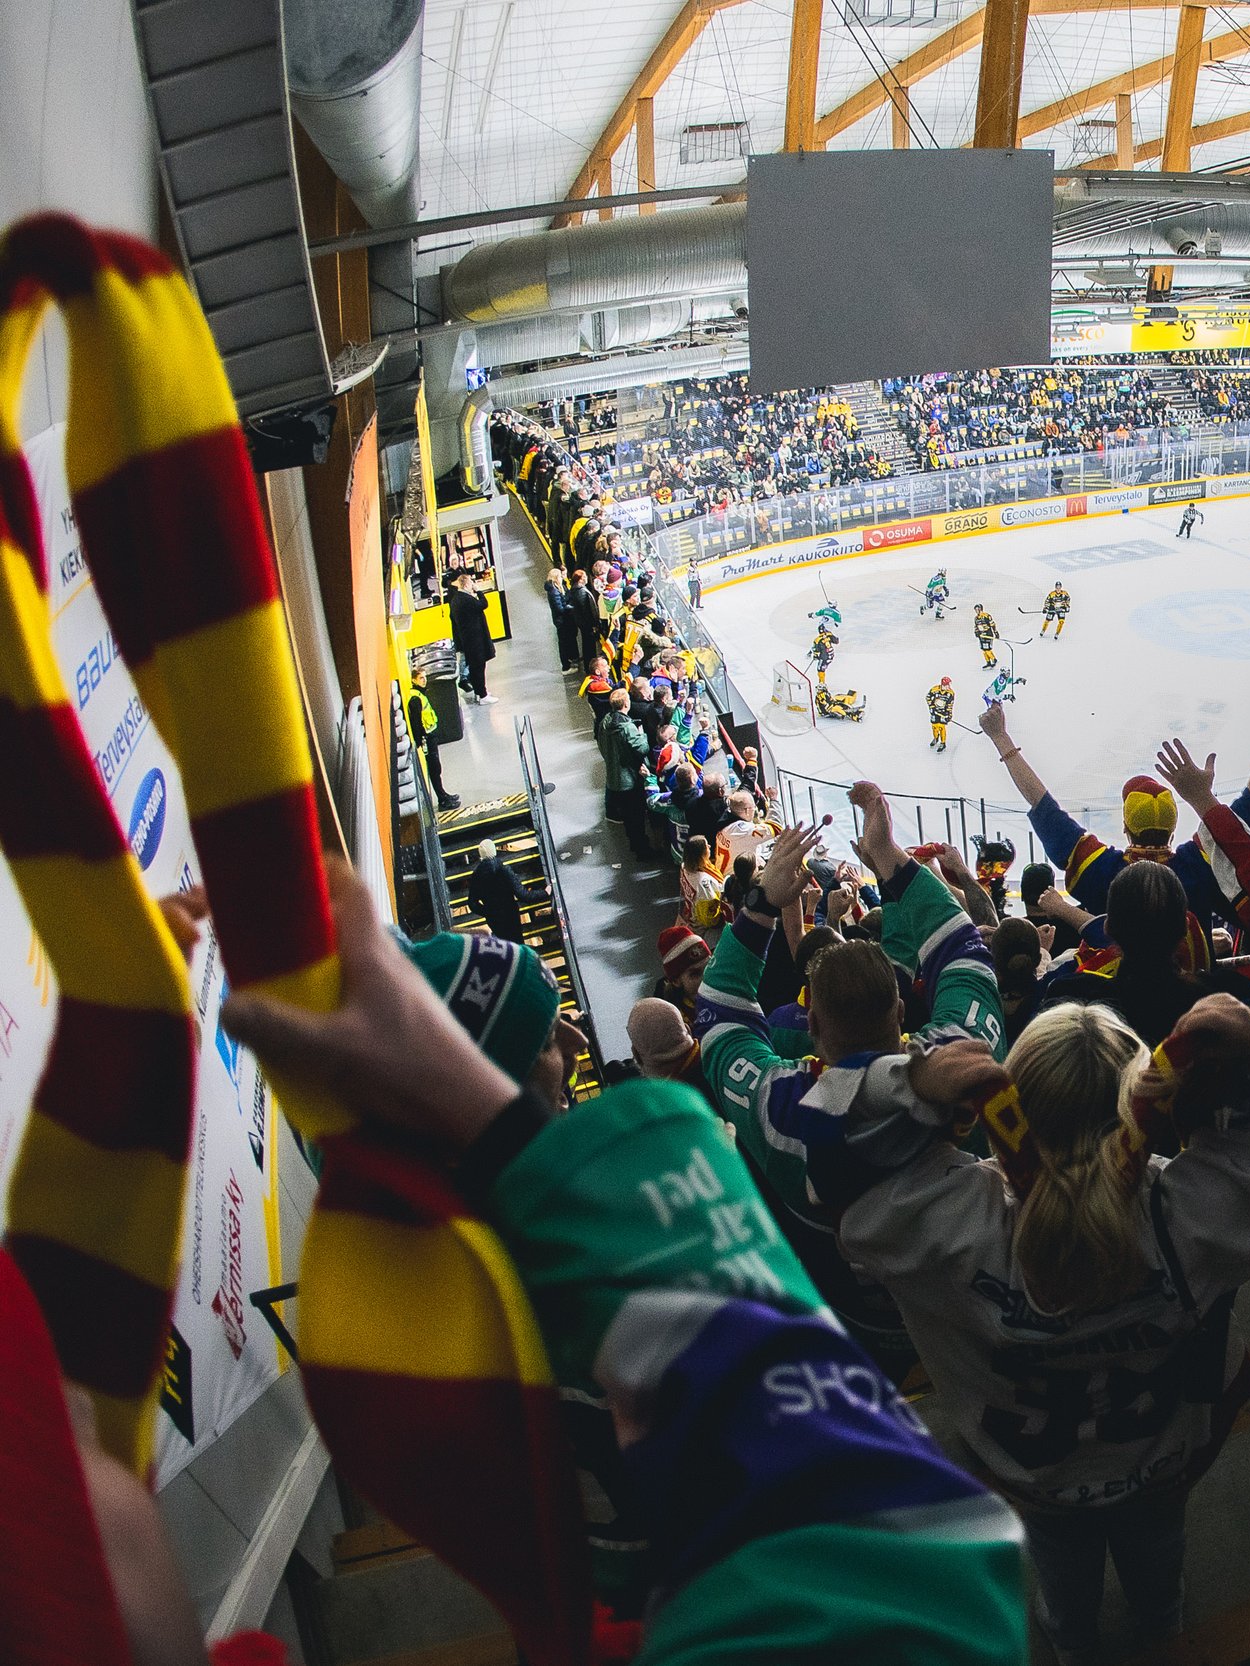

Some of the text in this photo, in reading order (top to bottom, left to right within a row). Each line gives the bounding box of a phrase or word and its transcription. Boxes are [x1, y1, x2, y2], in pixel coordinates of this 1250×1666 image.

[1094, 490, 1143, 504] Terveystalo
[886, 526, 923, 540] OSUMA
[944, 515, 988, 532] GRANO
[788, 543, 863, 565] KAUKOKIITO
[721, 554, 785, 579] ProMart
[723, 1056, 762, 1110] 51
